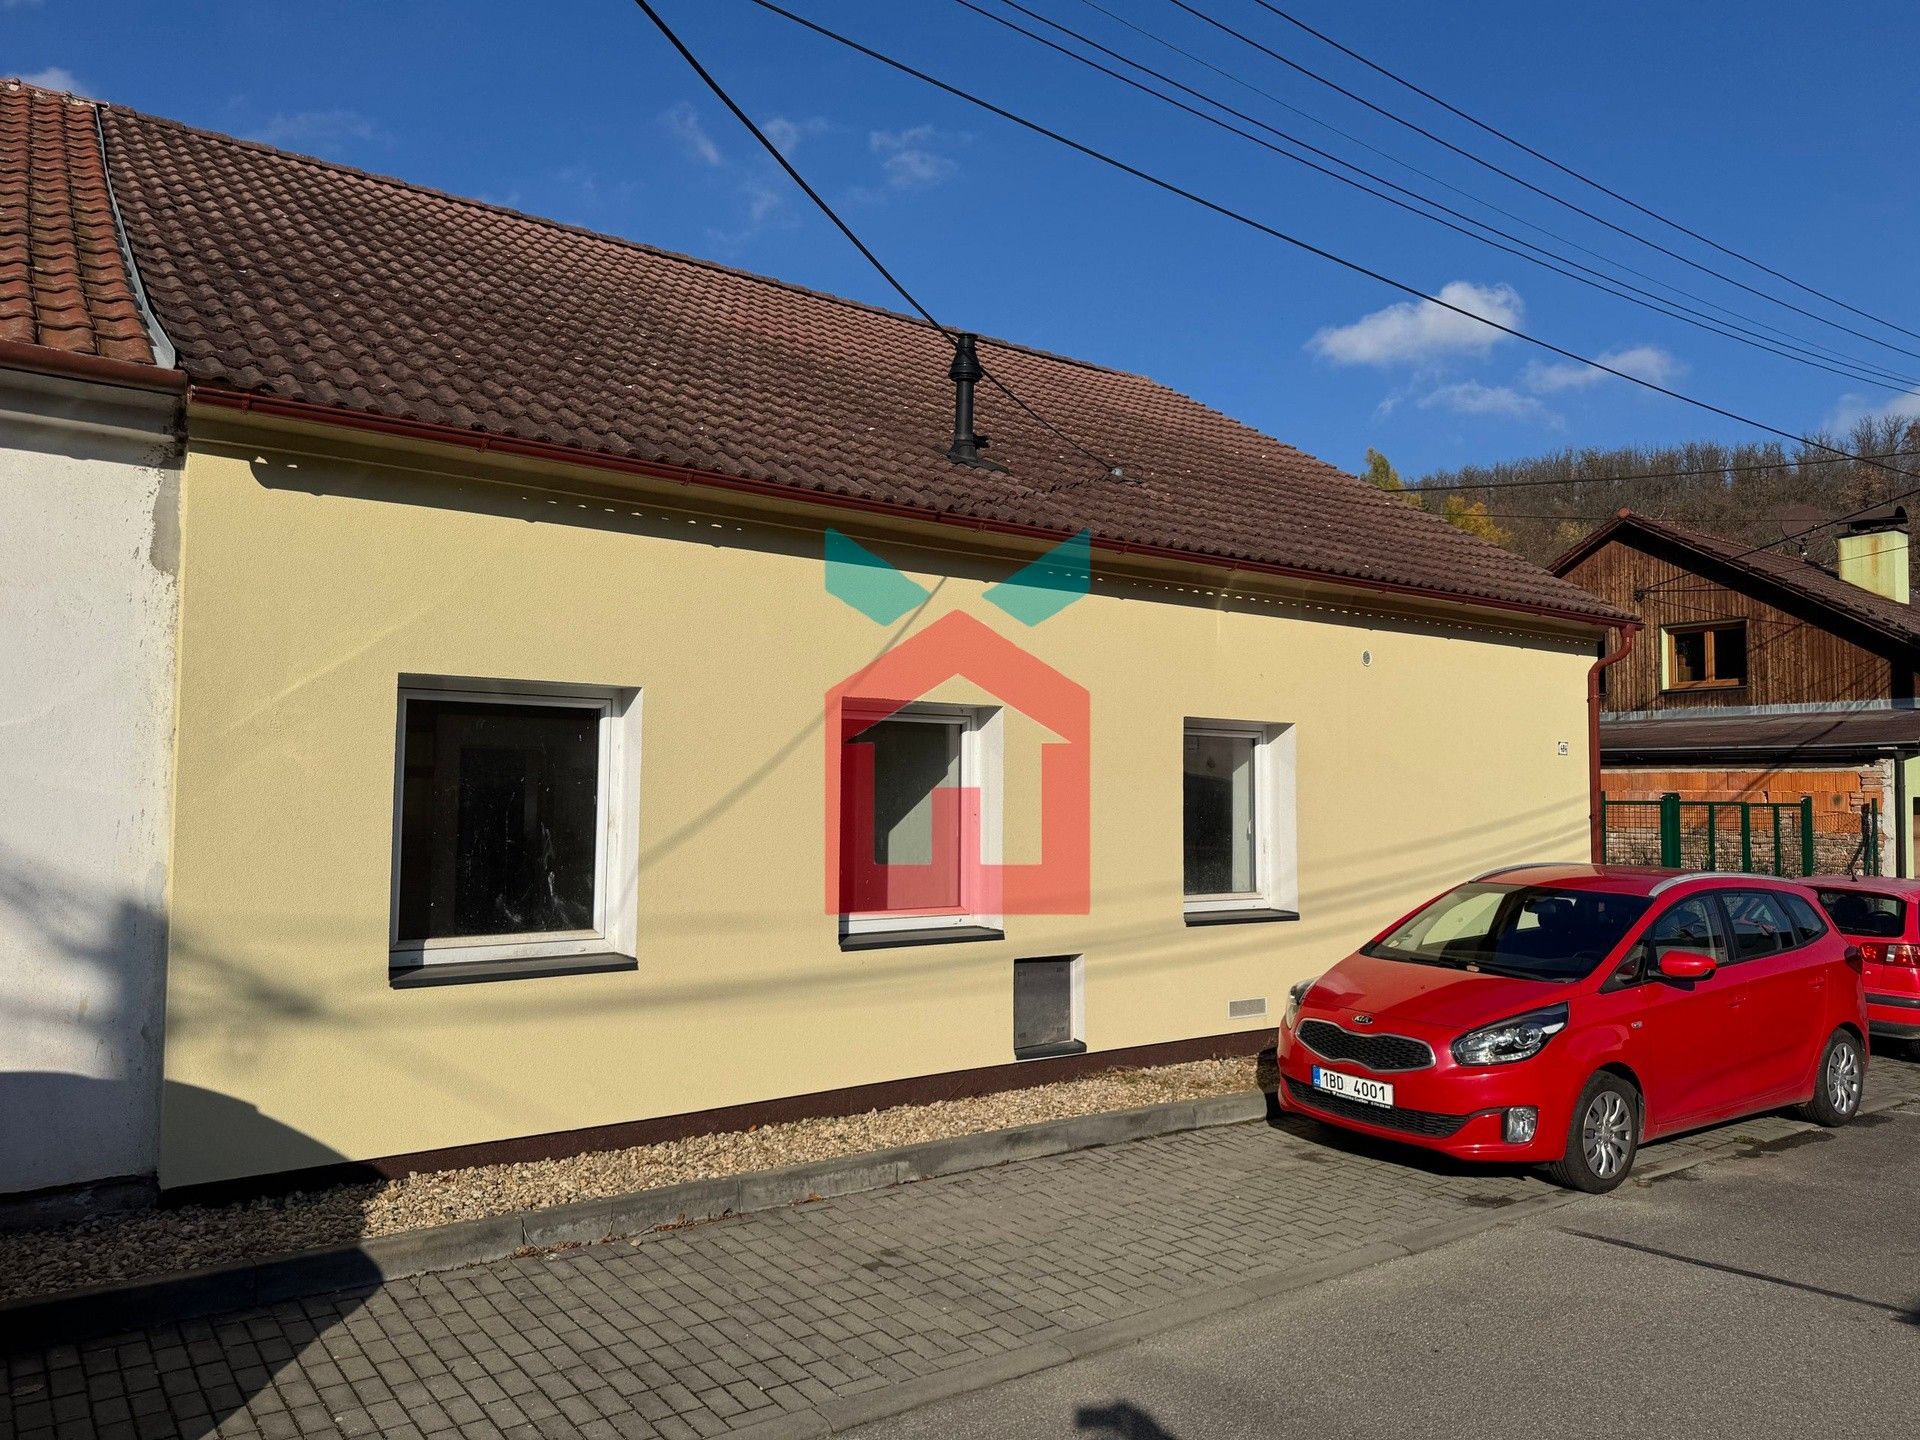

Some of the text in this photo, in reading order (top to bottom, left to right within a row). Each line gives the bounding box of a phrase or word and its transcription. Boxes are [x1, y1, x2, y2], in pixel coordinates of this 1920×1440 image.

[1355, 1015, 1369, 1023] KIA
[1323, 1072, 1344, 1091] 1BD
[1353, 1080, 1386, 1101] 4001
